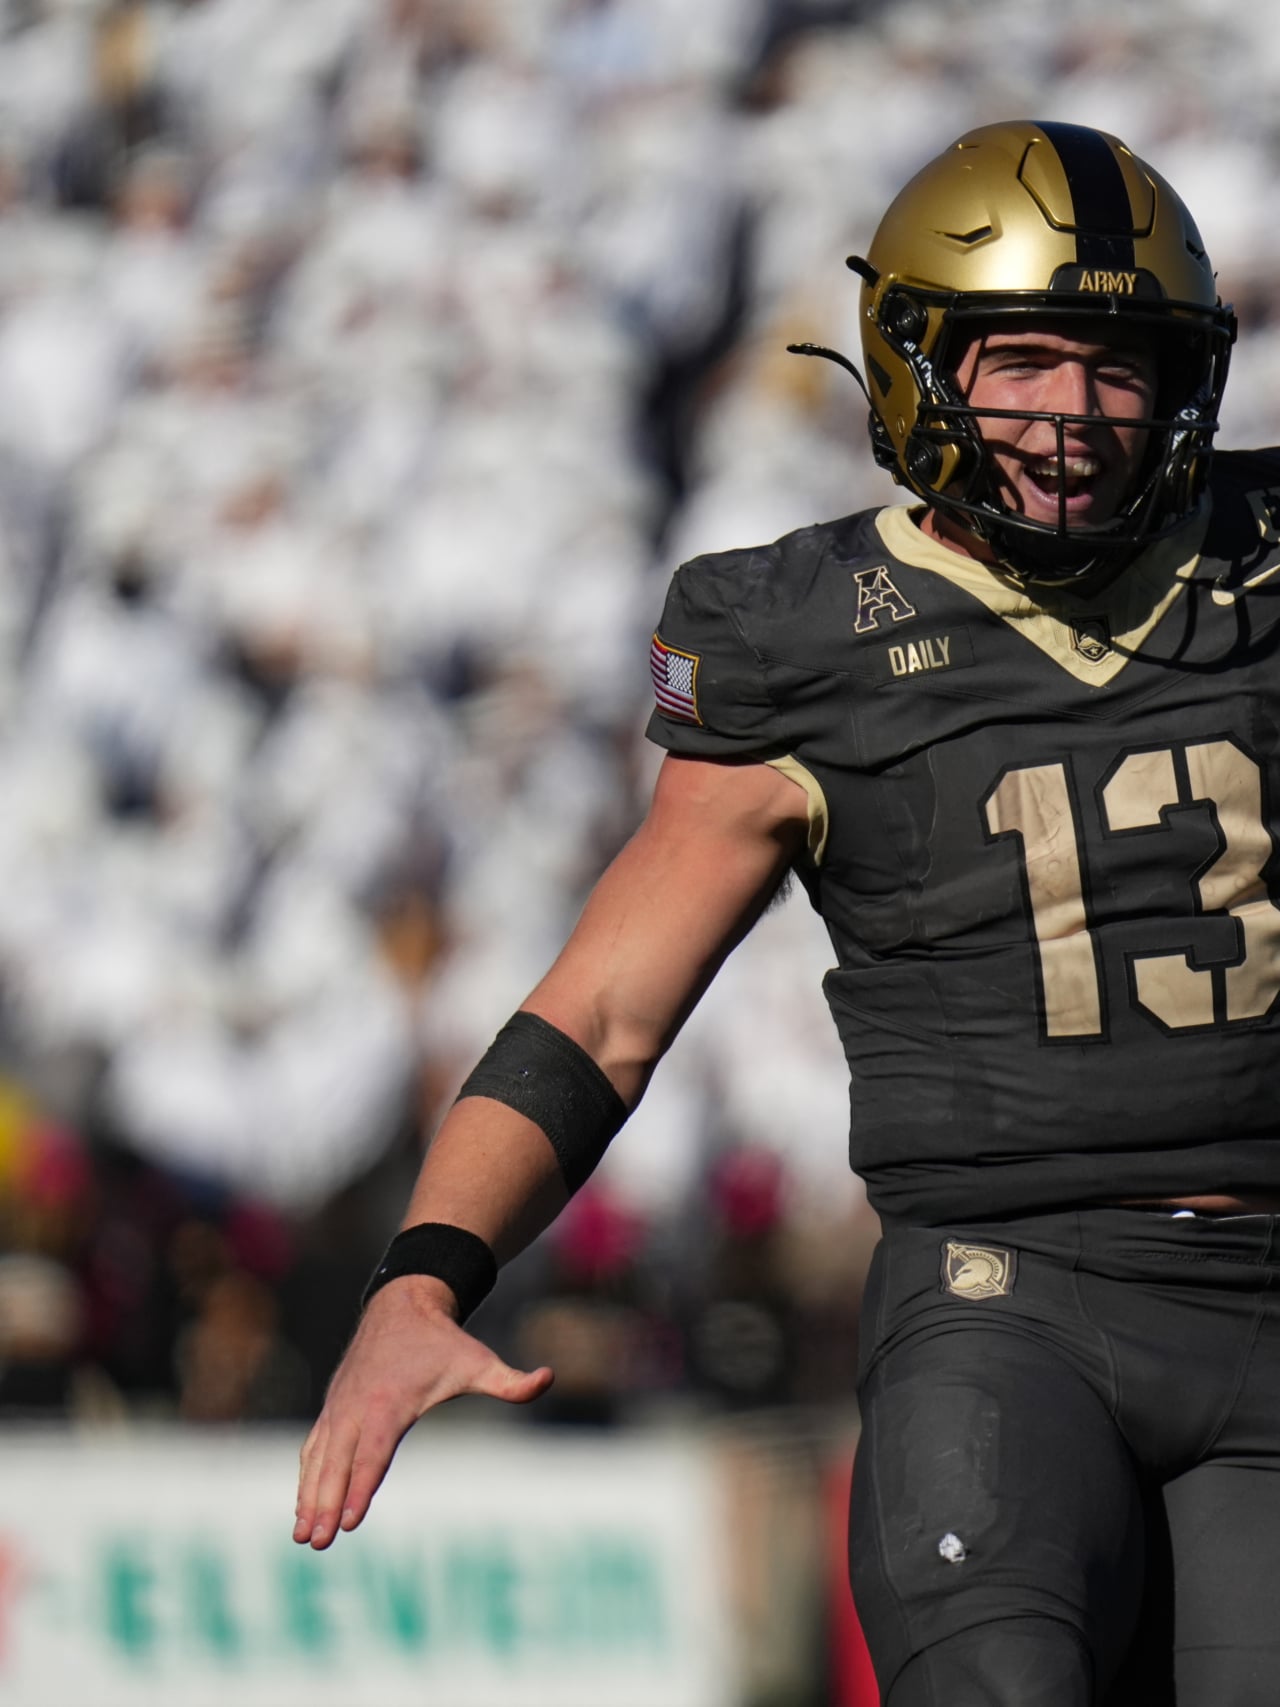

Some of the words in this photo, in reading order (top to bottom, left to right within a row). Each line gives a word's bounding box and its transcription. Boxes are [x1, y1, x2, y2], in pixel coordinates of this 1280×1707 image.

[1079, 270, 1137, 296] ARMY
[853, 564, 917, 634] A
[888, 635, 951, 677] DAILY
